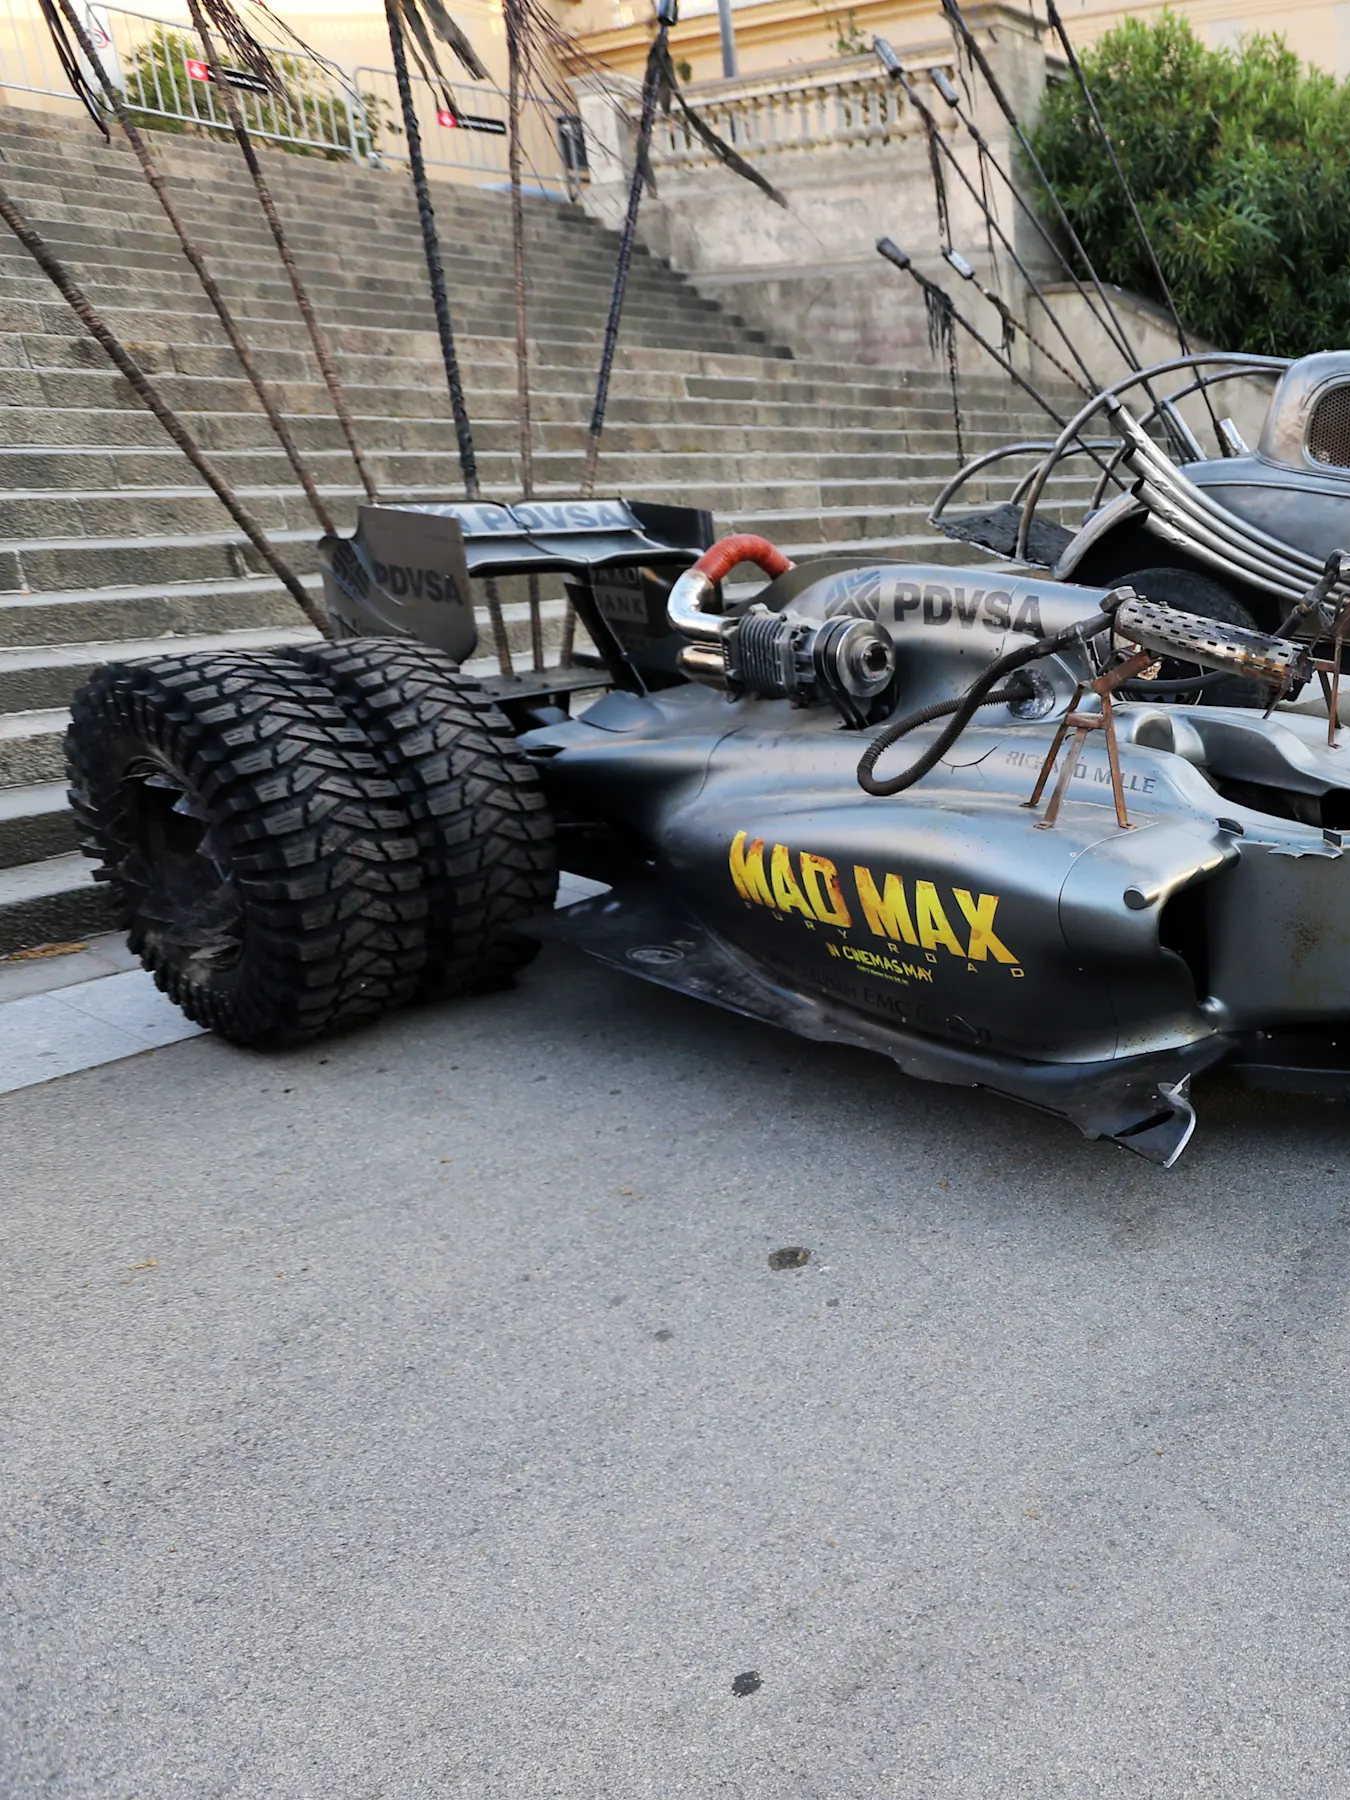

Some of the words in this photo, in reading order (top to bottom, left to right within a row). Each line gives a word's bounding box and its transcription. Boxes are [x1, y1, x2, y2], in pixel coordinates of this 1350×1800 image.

[474, 505, 630, 531] PDVSA
[373, 561, 464, 607] PDVSA
[894, 582, 1046, 639] PDVSA
[1093, 767, 1157, 795] MLLE
[729, 830, 853, 929] MAD
[853, 865, 1020, 965] MAX
[825, 942, 841, 958] IN
[842, 945, 903, 975] CINEMAS
[901, 962, 934, 983] MAY
[887, 942, 1025, 979] ROAD
